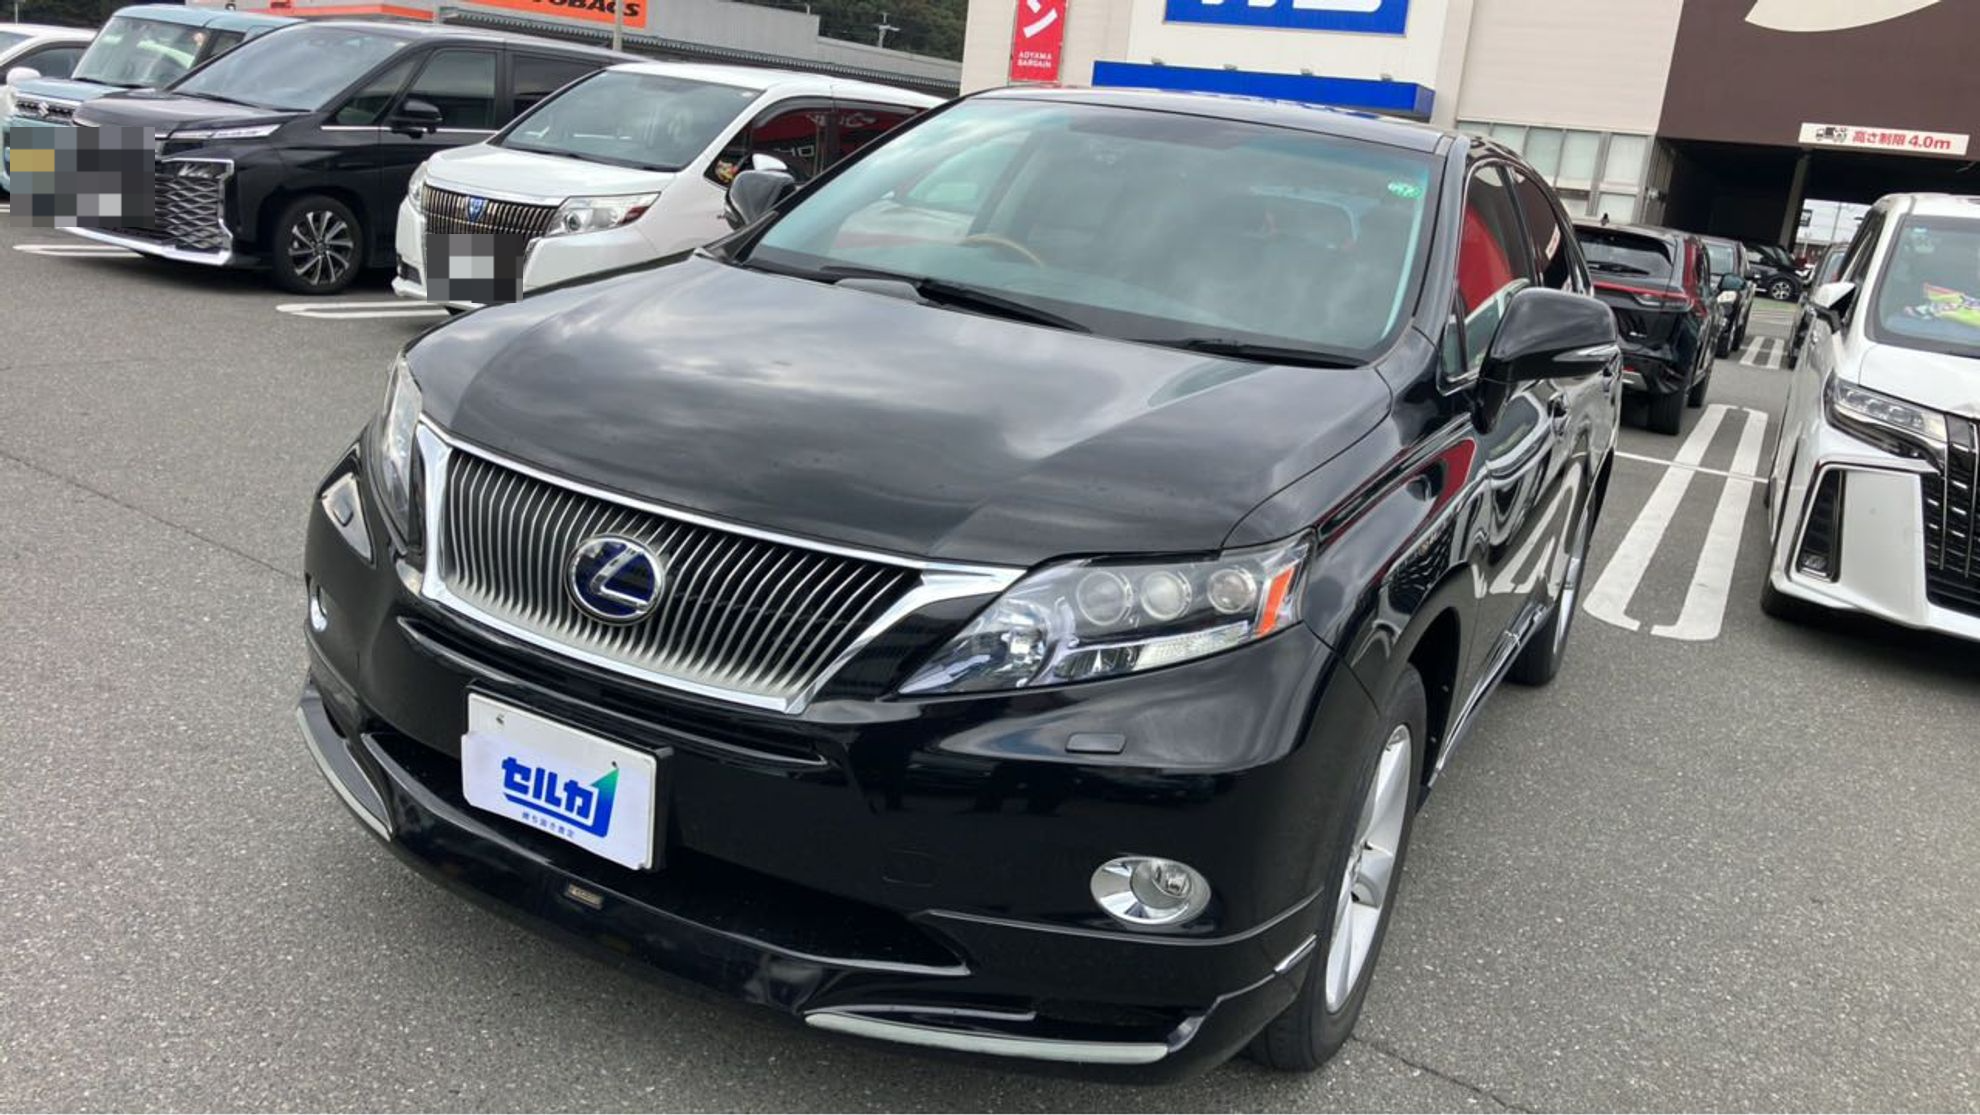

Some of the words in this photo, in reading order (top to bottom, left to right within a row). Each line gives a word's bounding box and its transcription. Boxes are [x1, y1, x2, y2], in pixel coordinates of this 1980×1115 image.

[1019, 51, 1051, 60] AOYAMA
[1017, 59, 1051, 69] BARGAIN
[1852, 131, 1906, 145] 高さ制限
[1908, 134, 1952, 150] 4.0m
